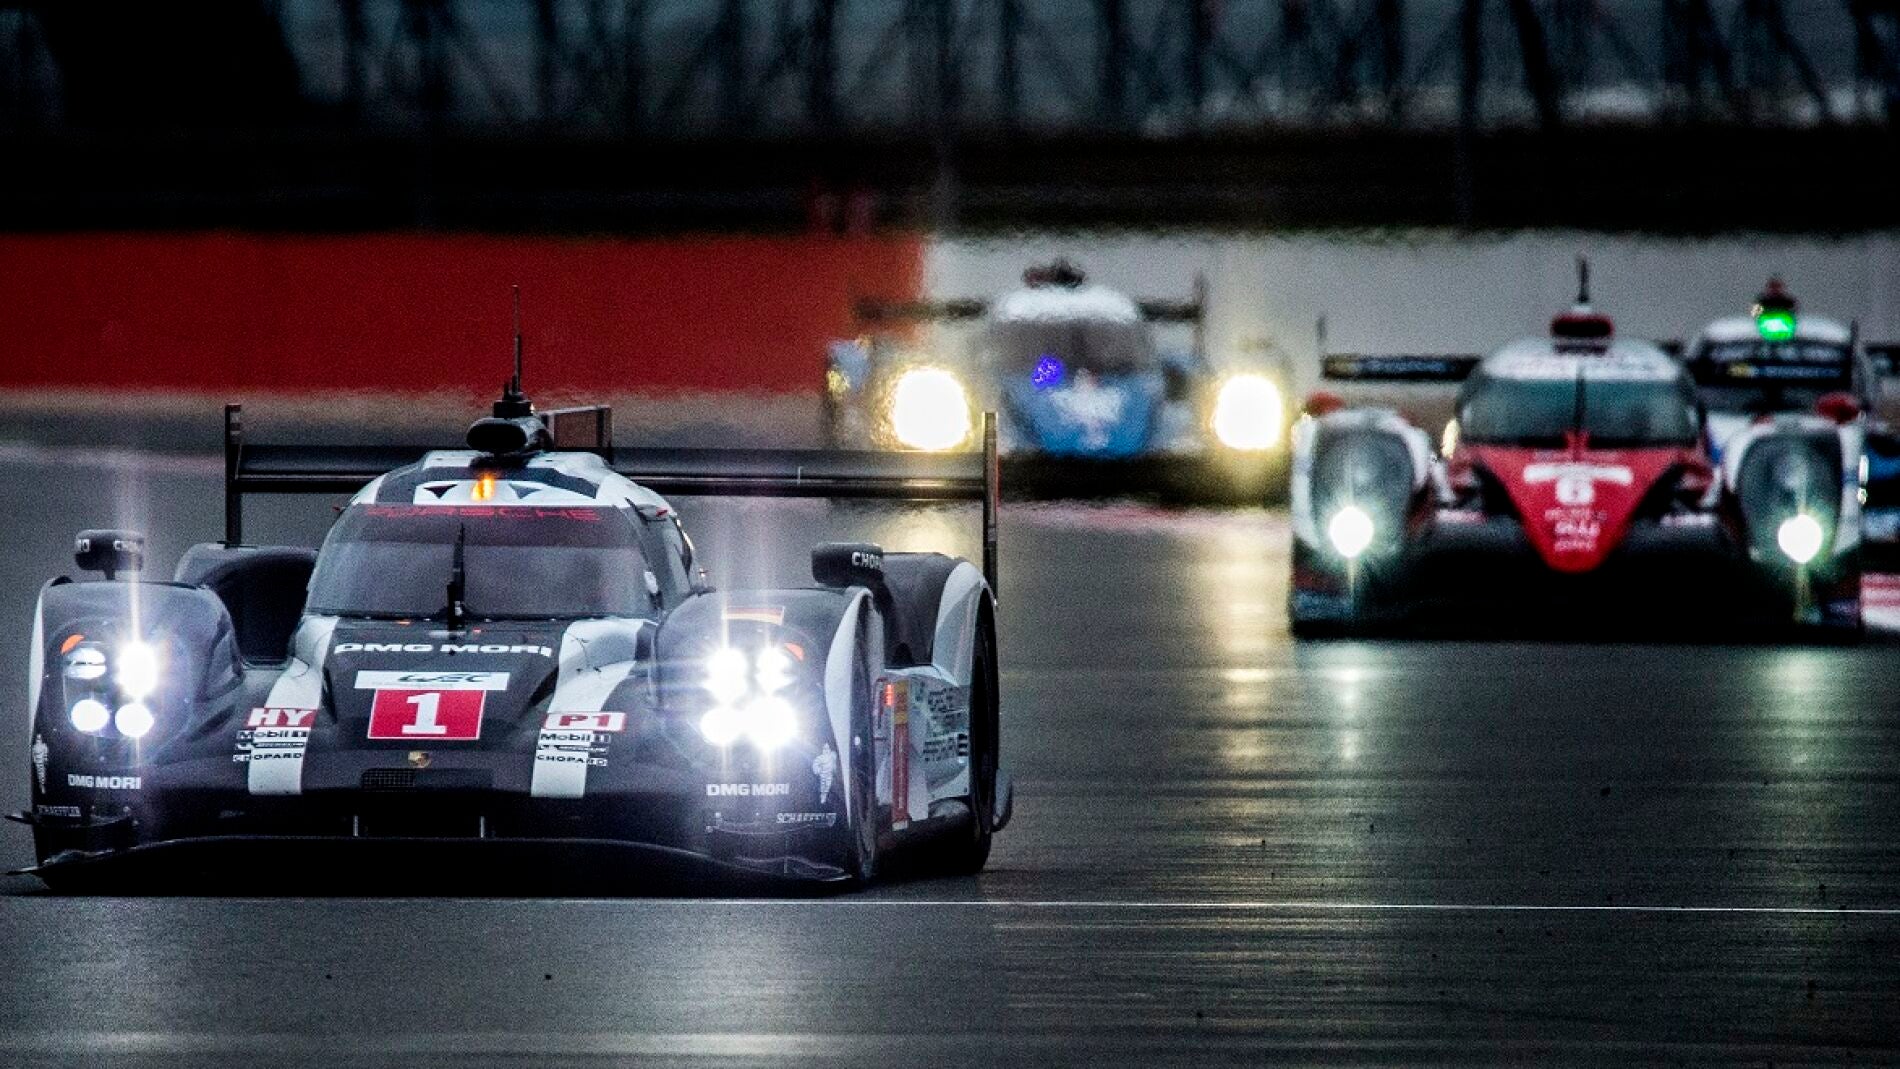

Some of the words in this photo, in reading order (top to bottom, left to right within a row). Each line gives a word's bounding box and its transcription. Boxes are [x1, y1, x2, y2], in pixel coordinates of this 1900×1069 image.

[333, 643, 434, 655] DMG
[440, 643, 553, 658] MORI
[247, 708, 315, 727] HY
[401, 692, 448, 735] 1
[558, 714, 611, 727] P1
[95, 776, 142, 790] MORI
[705, 783, 750, 796] DMG
[751, 783, 790, 796] MORI
